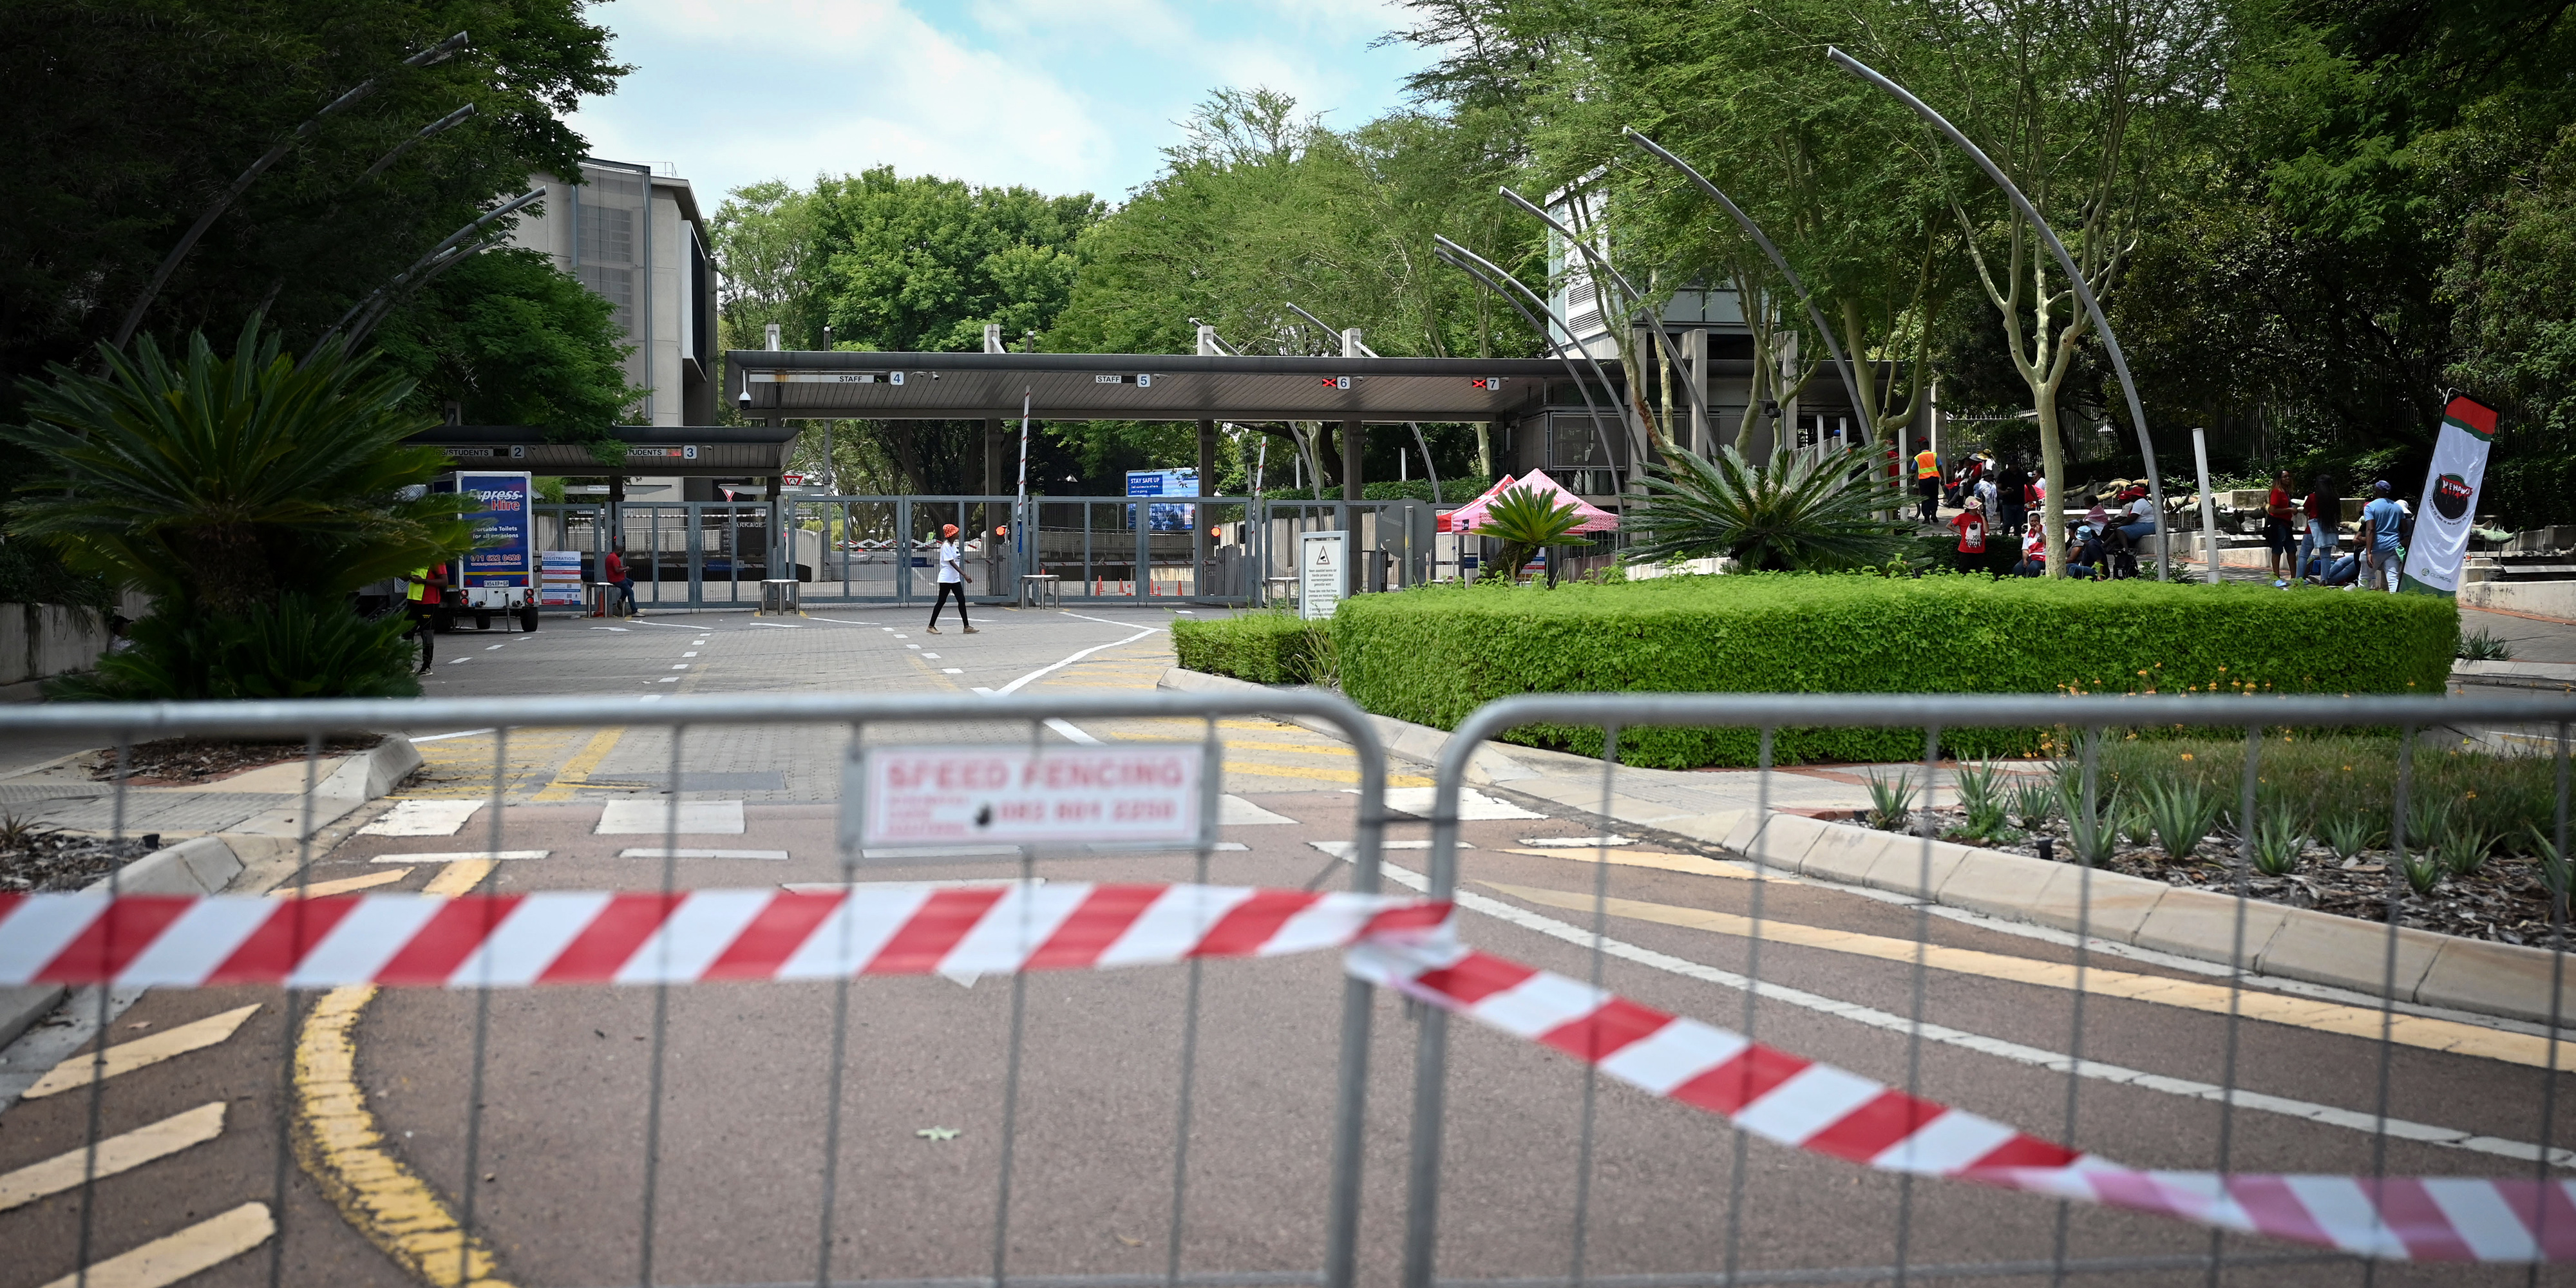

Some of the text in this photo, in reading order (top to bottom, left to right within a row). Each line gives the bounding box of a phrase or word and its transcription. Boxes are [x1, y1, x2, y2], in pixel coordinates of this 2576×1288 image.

[893, 374, 901, 383] 4
[1141, 376, 1148, 385] 5
[1340, 378, 1347, 388] 6
[1490, 379, 1497, 388] 7
[514, 447, 522, 457] 2
[687, 448, 694, 457] 3
[491, 499, 520, 511] Hire
